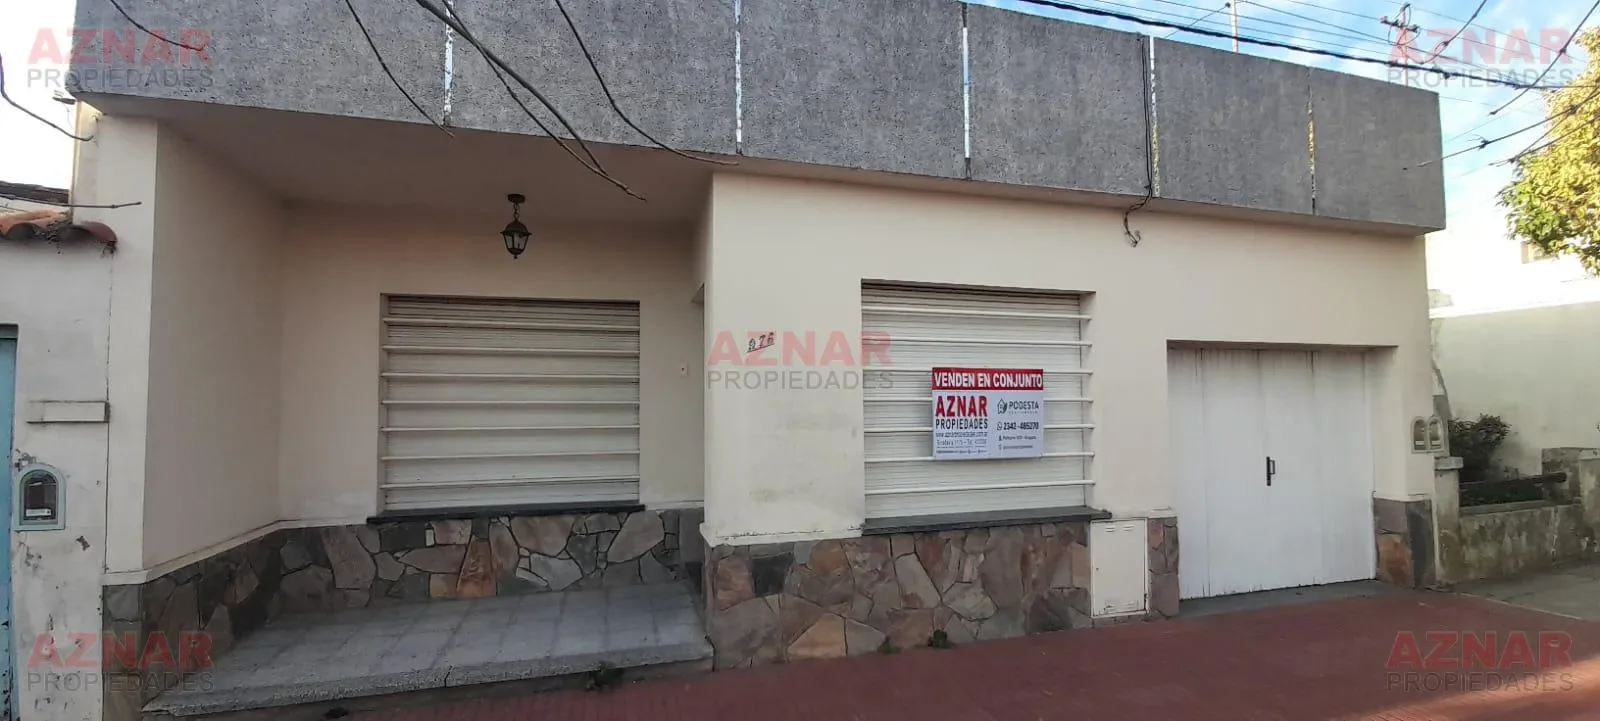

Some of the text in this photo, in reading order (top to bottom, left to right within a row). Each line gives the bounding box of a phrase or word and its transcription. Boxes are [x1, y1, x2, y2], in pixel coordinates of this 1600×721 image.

[934, 372, 1043, 388] VENDEN EN CONJUNTO
[935, 395, 988, 417] AZNAR
[1008, 400, 1040, 411] PODESTA
[935, 418, 988, 430] PROPIEDADES
